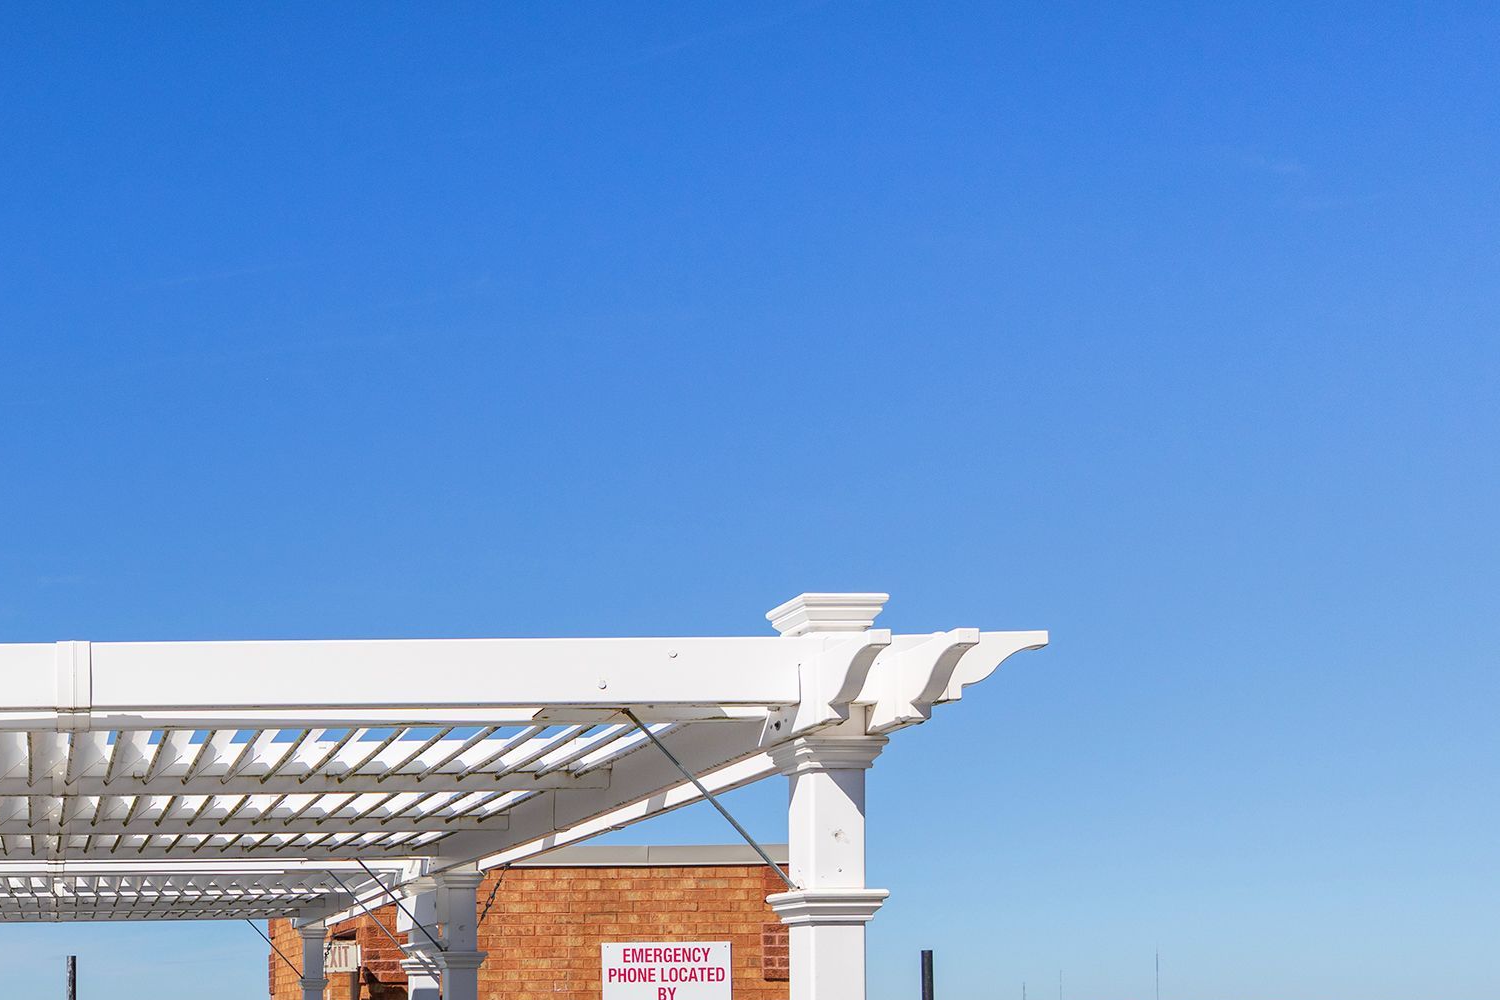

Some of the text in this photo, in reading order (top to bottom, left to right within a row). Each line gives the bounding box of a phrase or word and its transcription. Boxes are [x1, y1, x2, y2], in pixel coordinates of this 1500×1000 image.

[324, 945, 349, 967] XIT
[623, 947, 710, 963] EMERGENCY
[608, 967, 725, 983] PHONE LOCATED
